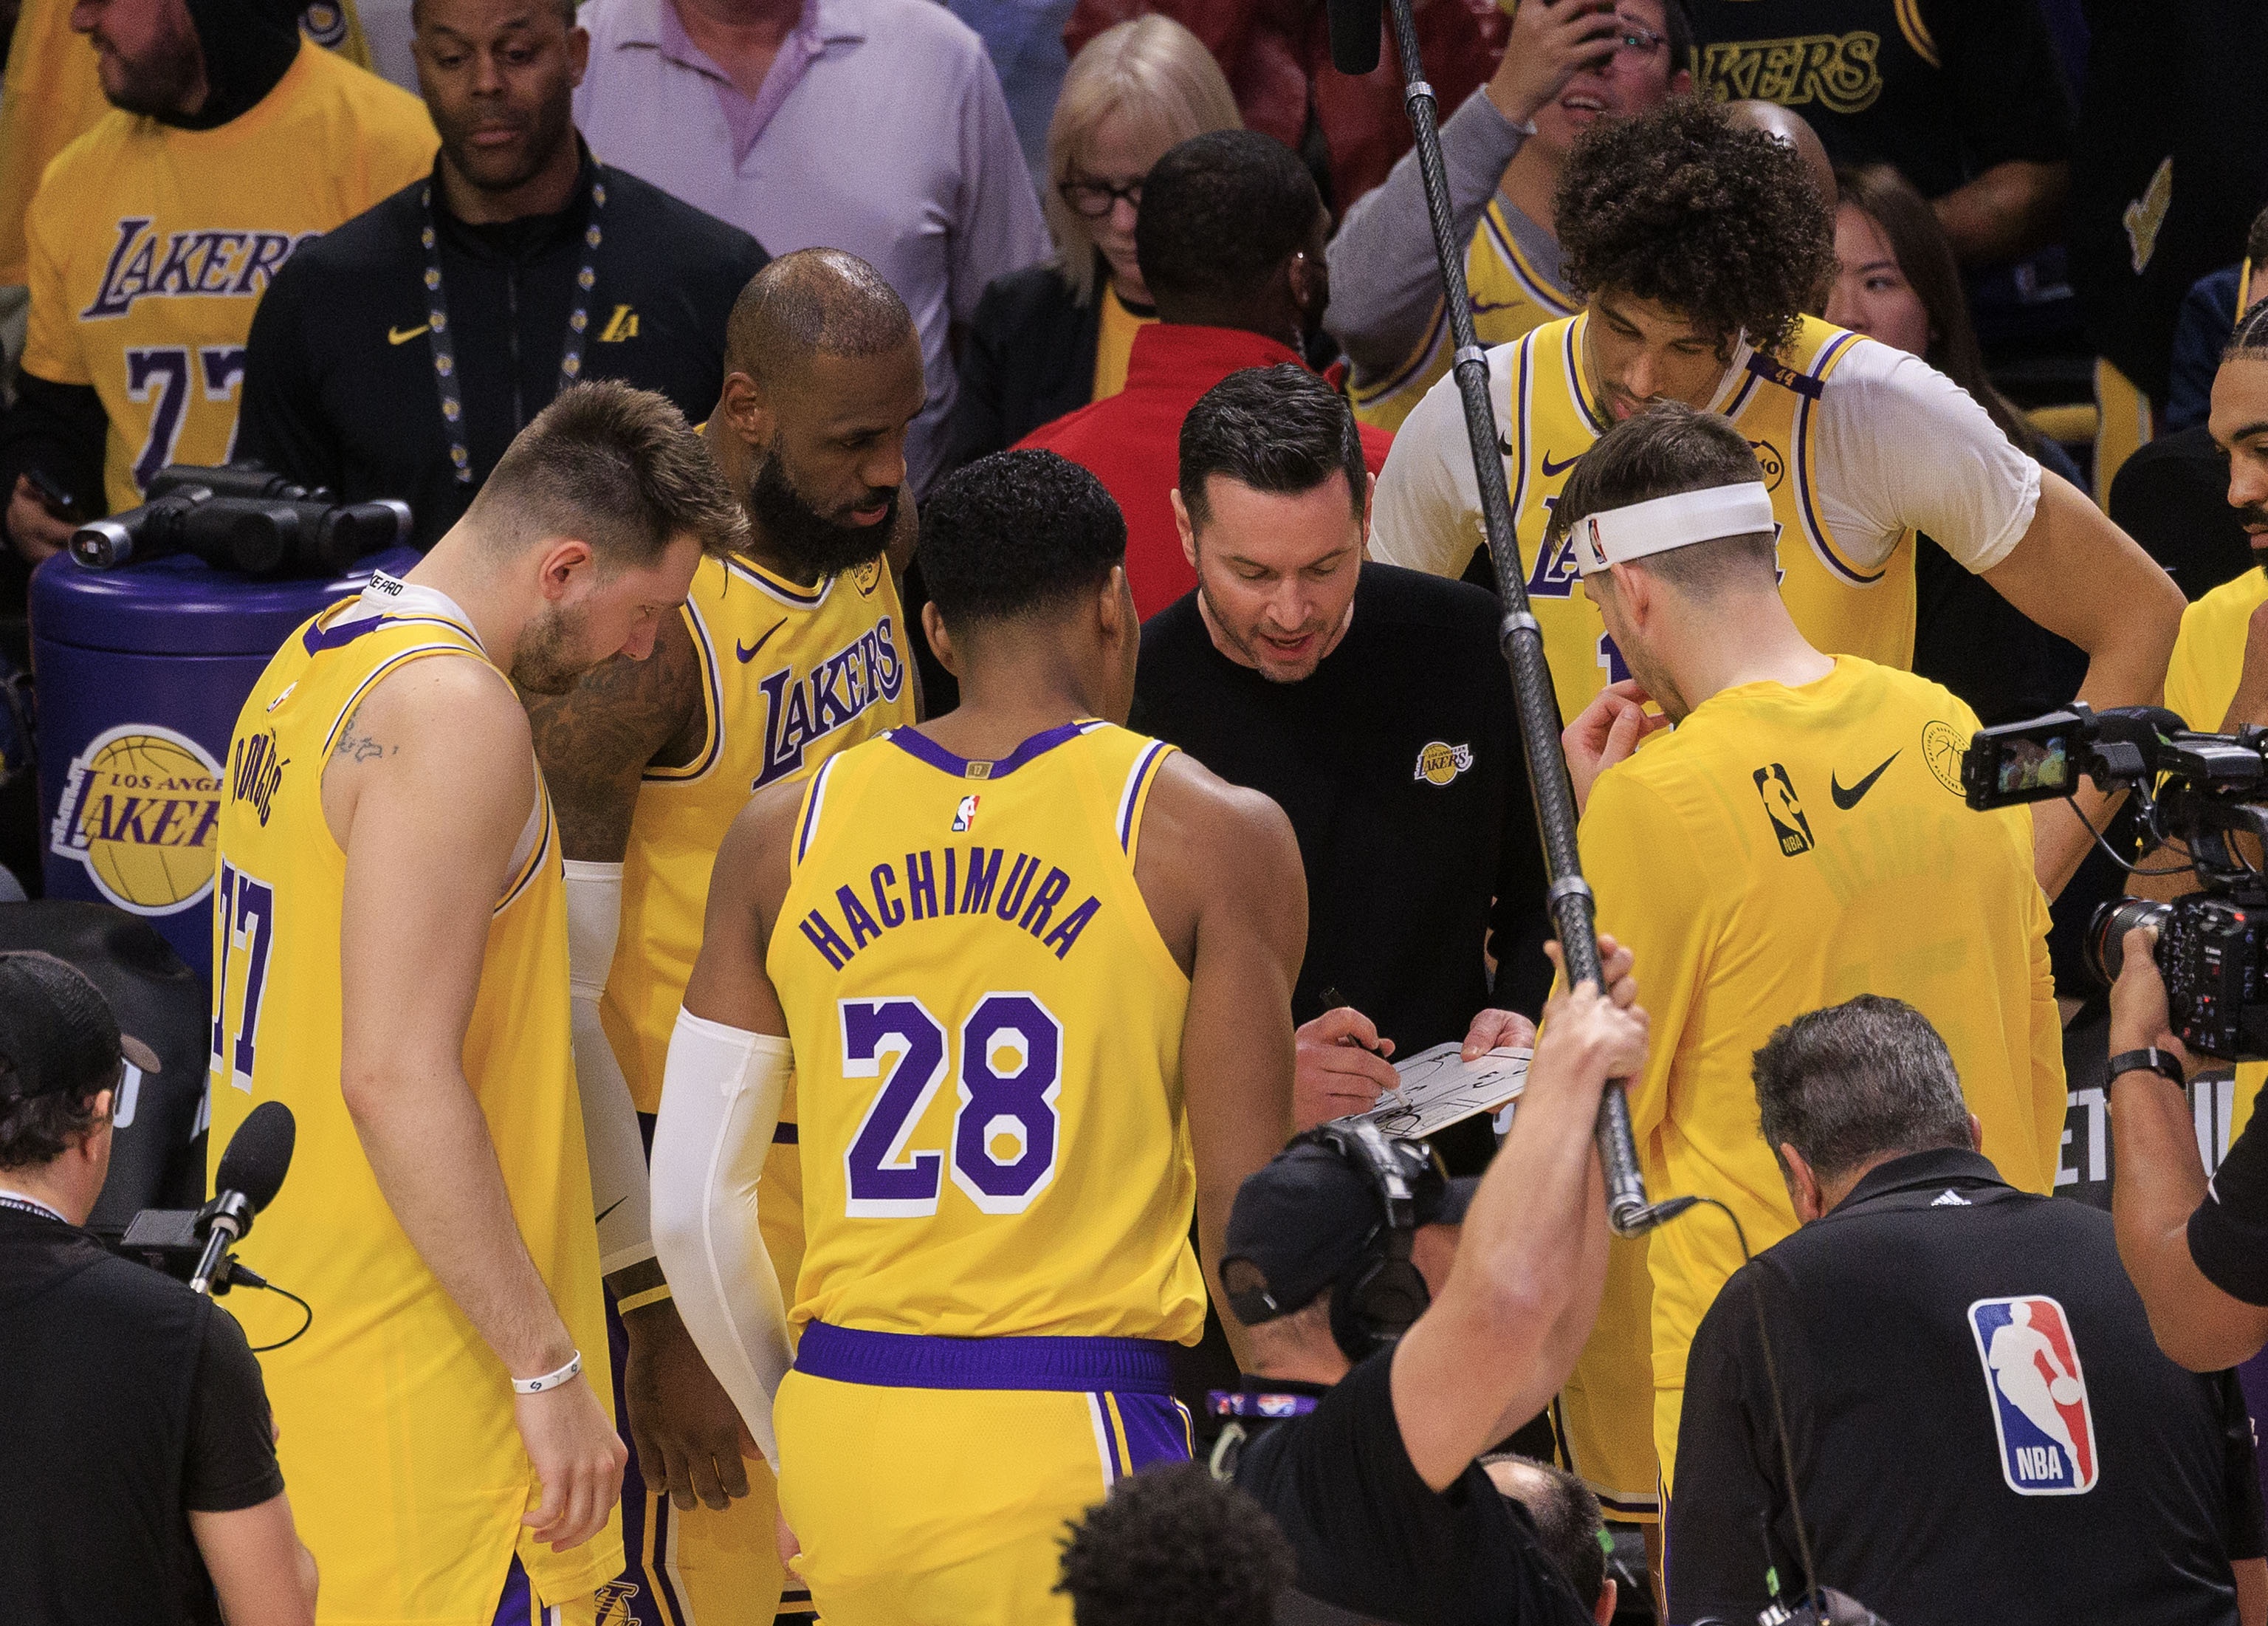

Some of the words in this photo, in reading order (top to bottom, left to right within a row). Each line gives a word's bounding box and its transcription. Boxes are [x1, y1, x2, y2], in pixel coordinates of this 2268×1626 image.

[1689, 31, 1883, 114] KERS
[78, 216, 322, 322] LAKER
[1775, 369, 1797, 387] 44
[377, 580, 404, 597] PRO
[750, 615, 905, 795] LAKERS
[111, 773, 152, 789] LOS
[1416, 750, 1472, 778] LAKERS
[1782, 834, 1803, 854] NBA
[798, 846, 1102, 972] HACHIMURA
[210, 851, 274, 1096] 77
[837, 990, 1065, 1219] 28
[2016, 1445, 2063, 1481] NBA
